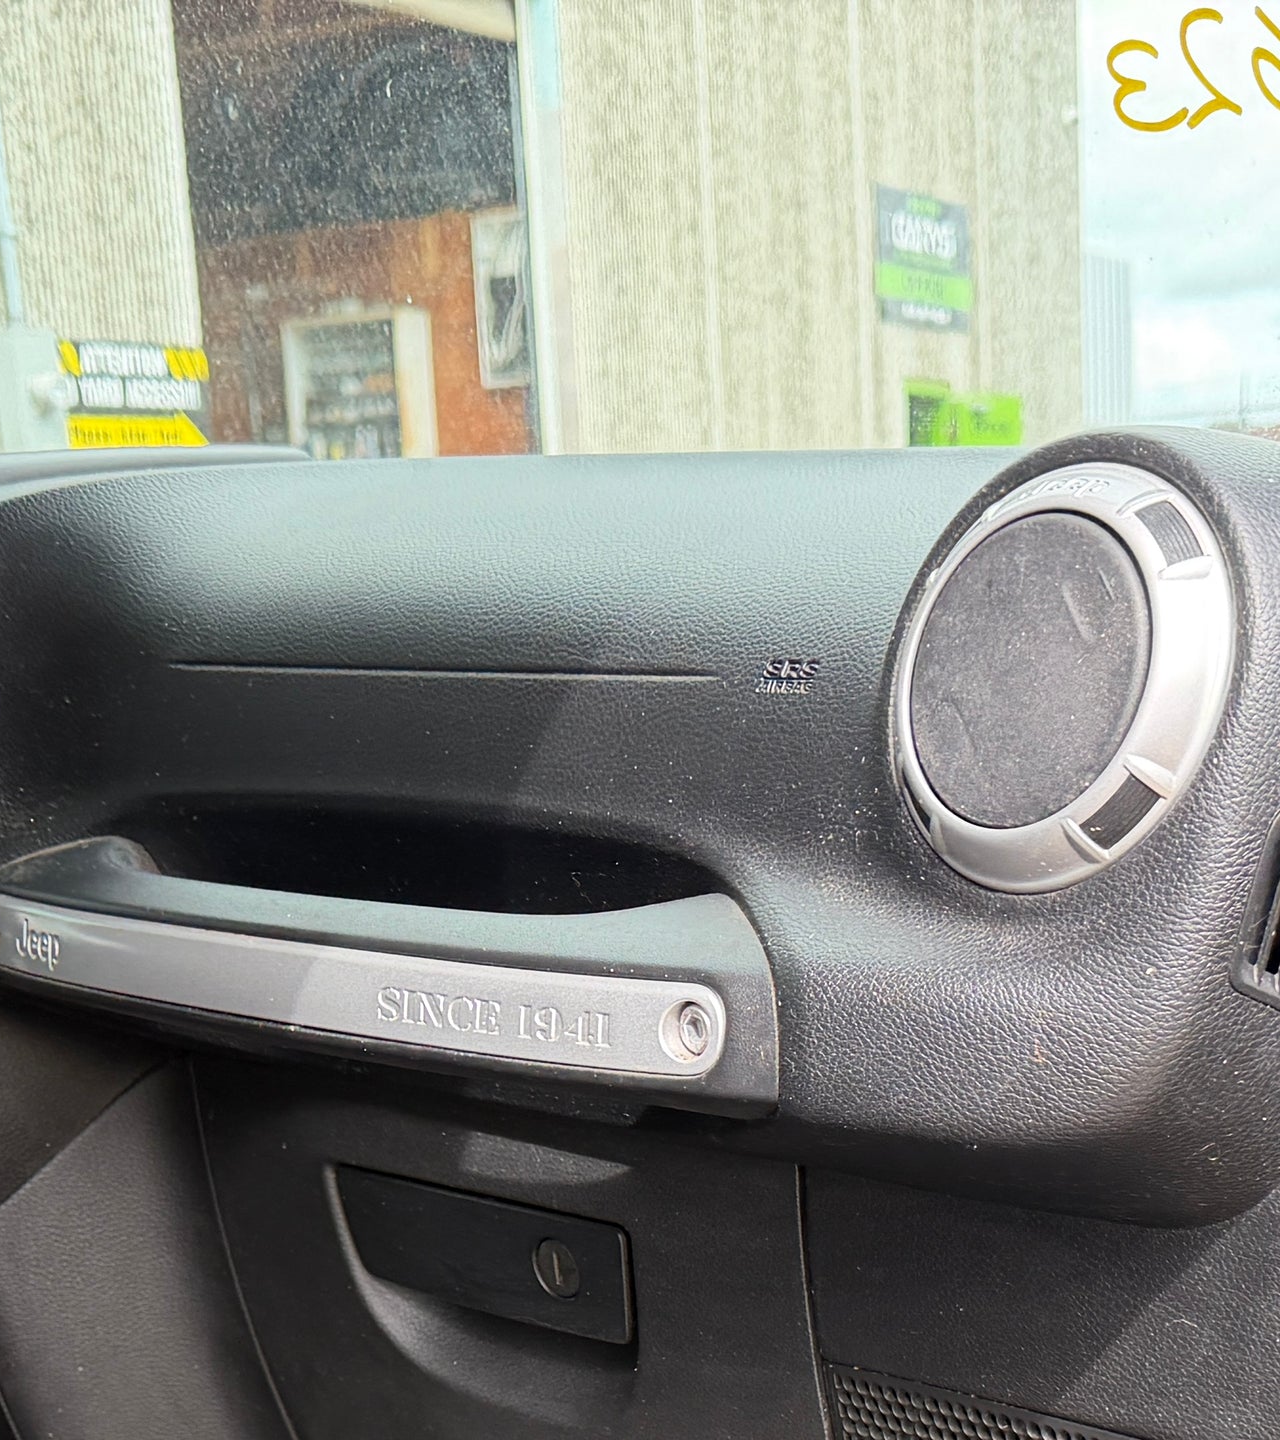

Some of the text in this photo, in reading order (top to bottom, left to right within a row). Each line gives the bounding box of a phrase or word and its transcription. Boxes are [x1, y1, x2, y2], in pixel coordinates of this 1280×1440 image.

[762, 658, 820, 678] SRS
[15, 917, 60, 971] Jeep
[374, 985, 614, 1049] SINCE 1941
